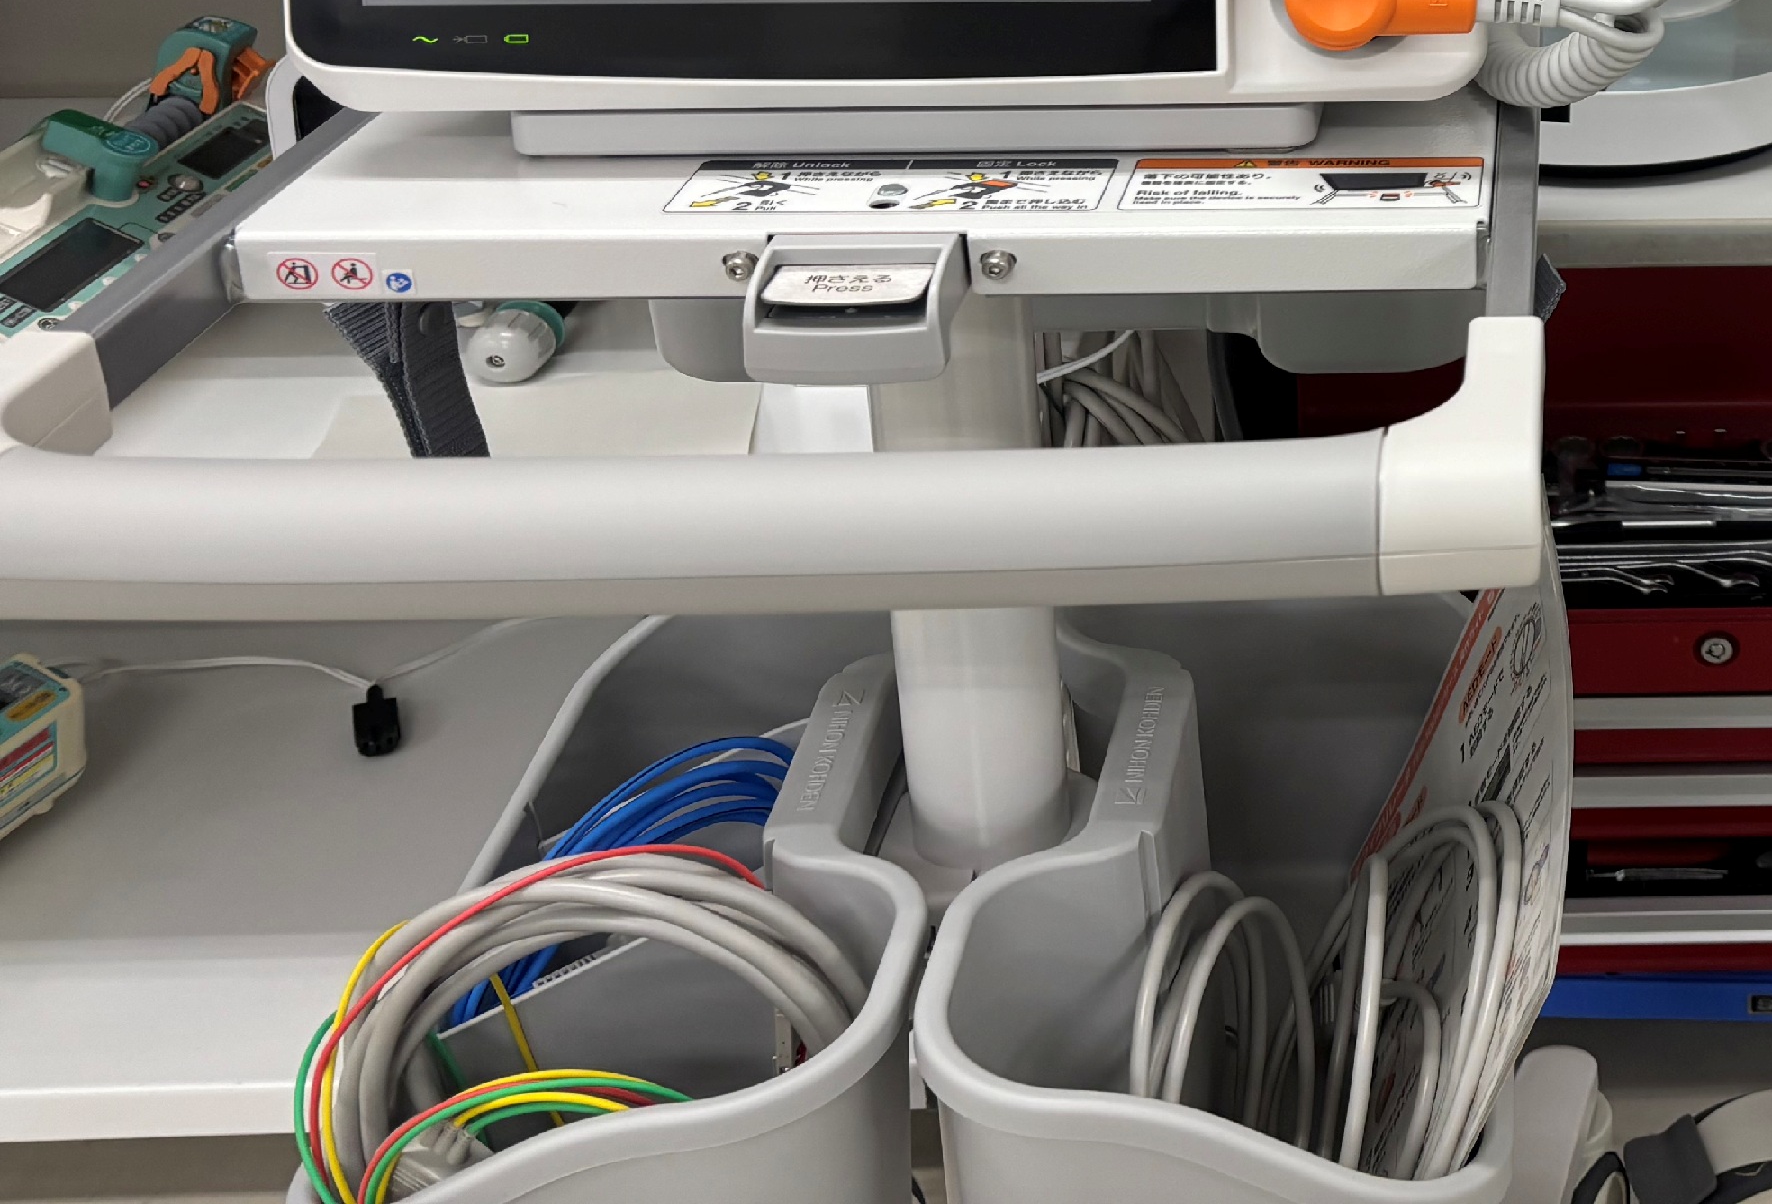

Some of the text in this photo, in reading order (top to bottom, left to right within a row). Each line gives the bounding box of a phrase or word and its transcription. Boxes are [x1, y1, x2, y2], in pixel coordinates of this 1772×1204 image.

[780, 171, 791, 181] 1
[999, 170, 1012, 179] 1
[732, 201, 752, 210] 2
[959, 201, 978, 209] 2
[804, 274, 892, 285] 押さえる
[811, 283, 873, 293] Press
[1125, 685, 1166, 784] NIHON KOHDEN
[796, 707, 855, 813] NIHON KOHDEN
